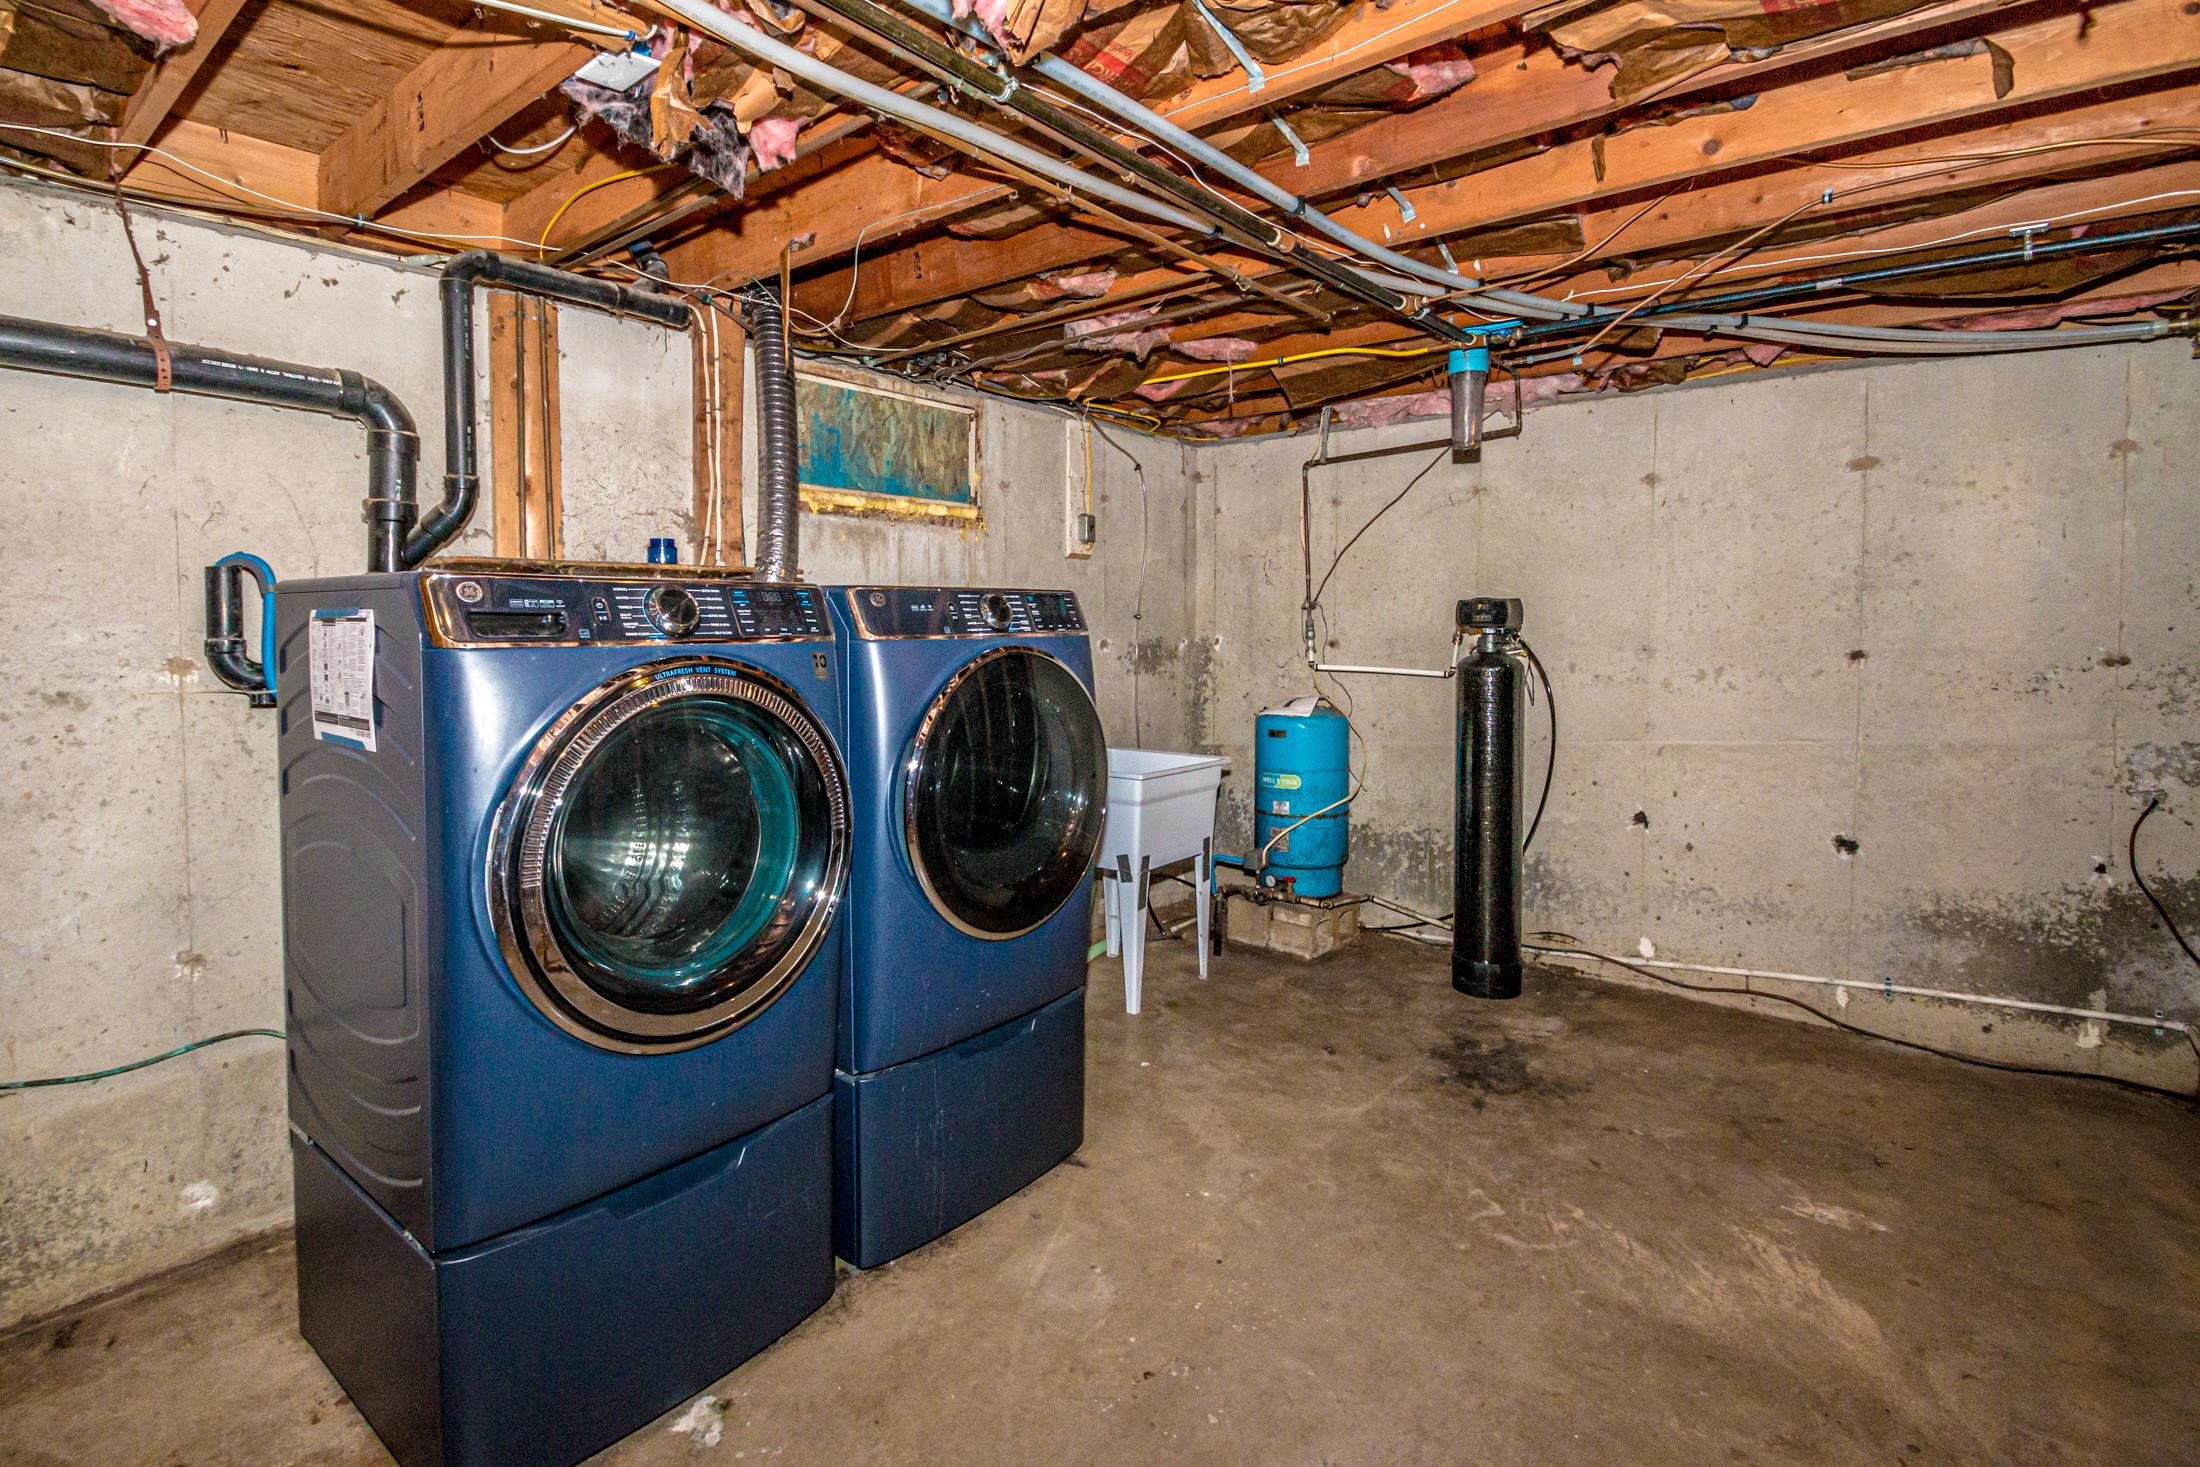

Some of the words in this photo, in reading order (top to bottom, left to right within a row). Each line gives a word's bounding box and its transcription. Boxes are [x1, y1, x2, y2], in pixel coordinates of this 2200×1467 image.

[655, 667, 694, 680] ULTRAFRESH
[695, 666, 711, 674] VENT
[714, 667, 737, 677] SYSTEM
